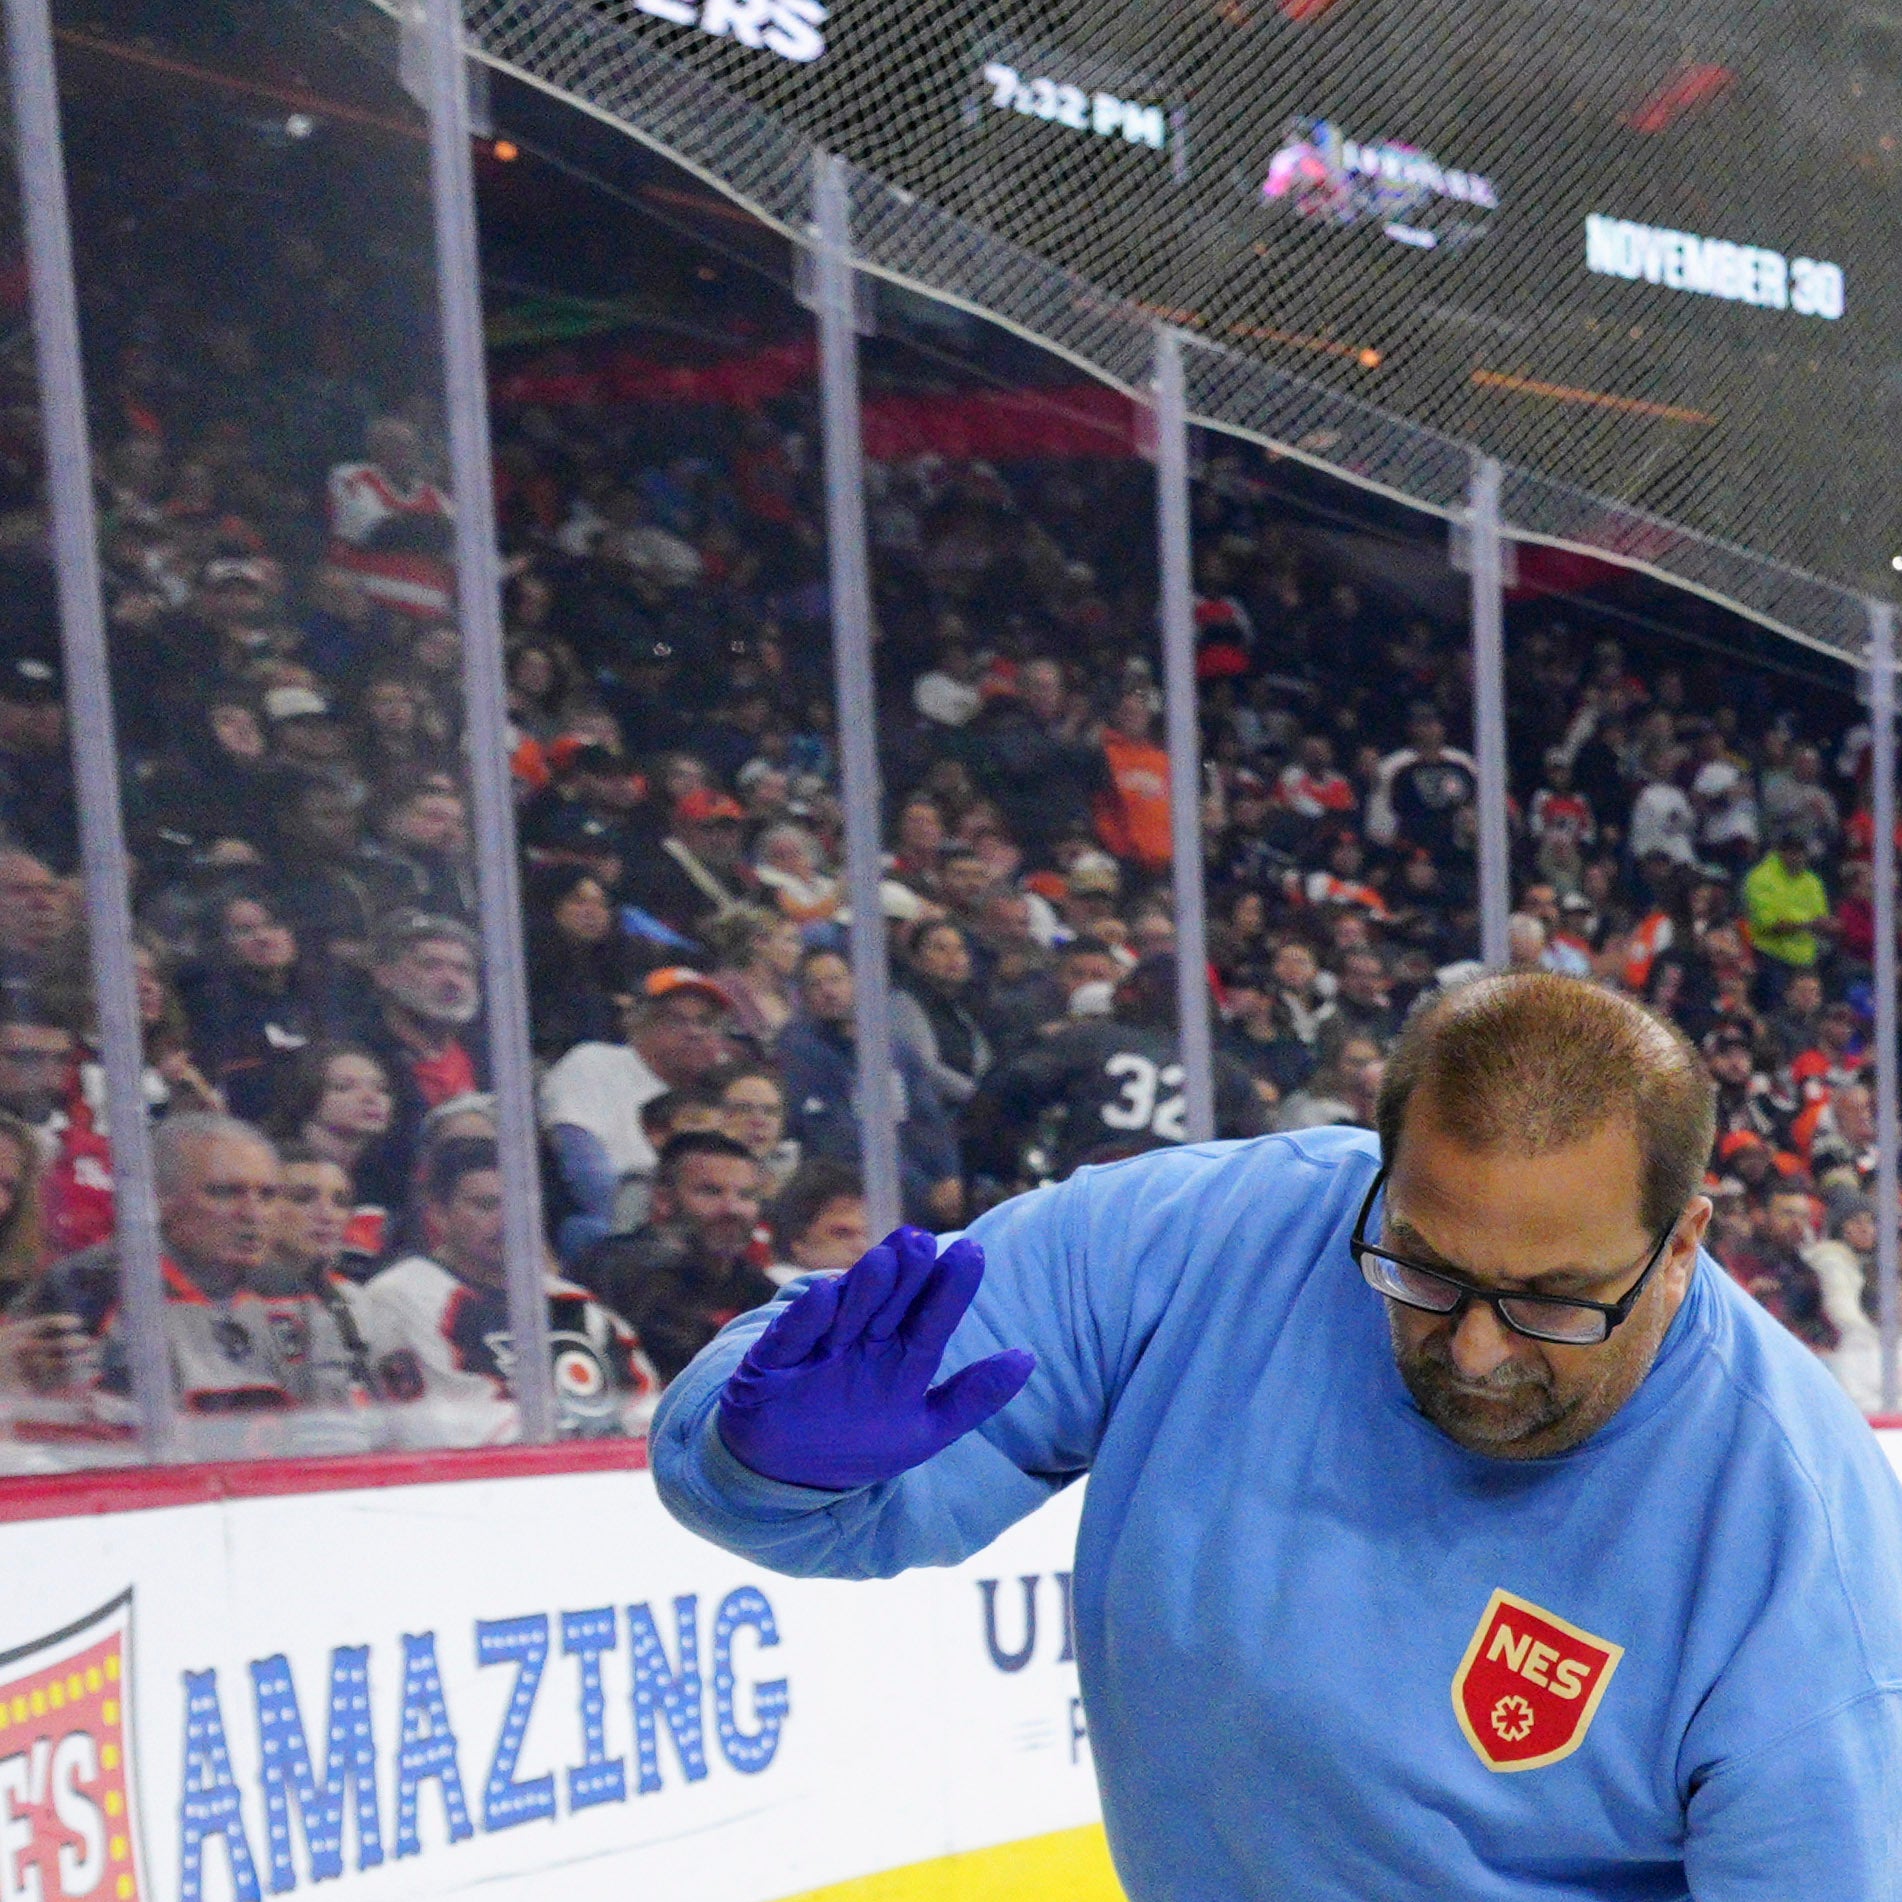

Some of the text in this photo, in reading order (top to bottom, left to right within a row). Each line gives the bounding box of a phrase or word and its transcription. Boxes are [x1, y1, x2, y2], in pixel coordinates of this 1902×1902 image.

[1092, 91, 1166, 149] PM
[1585, 212, 1845, 320] NOVEMBER 30
[1486, 1623, 1592, 1701] NES
